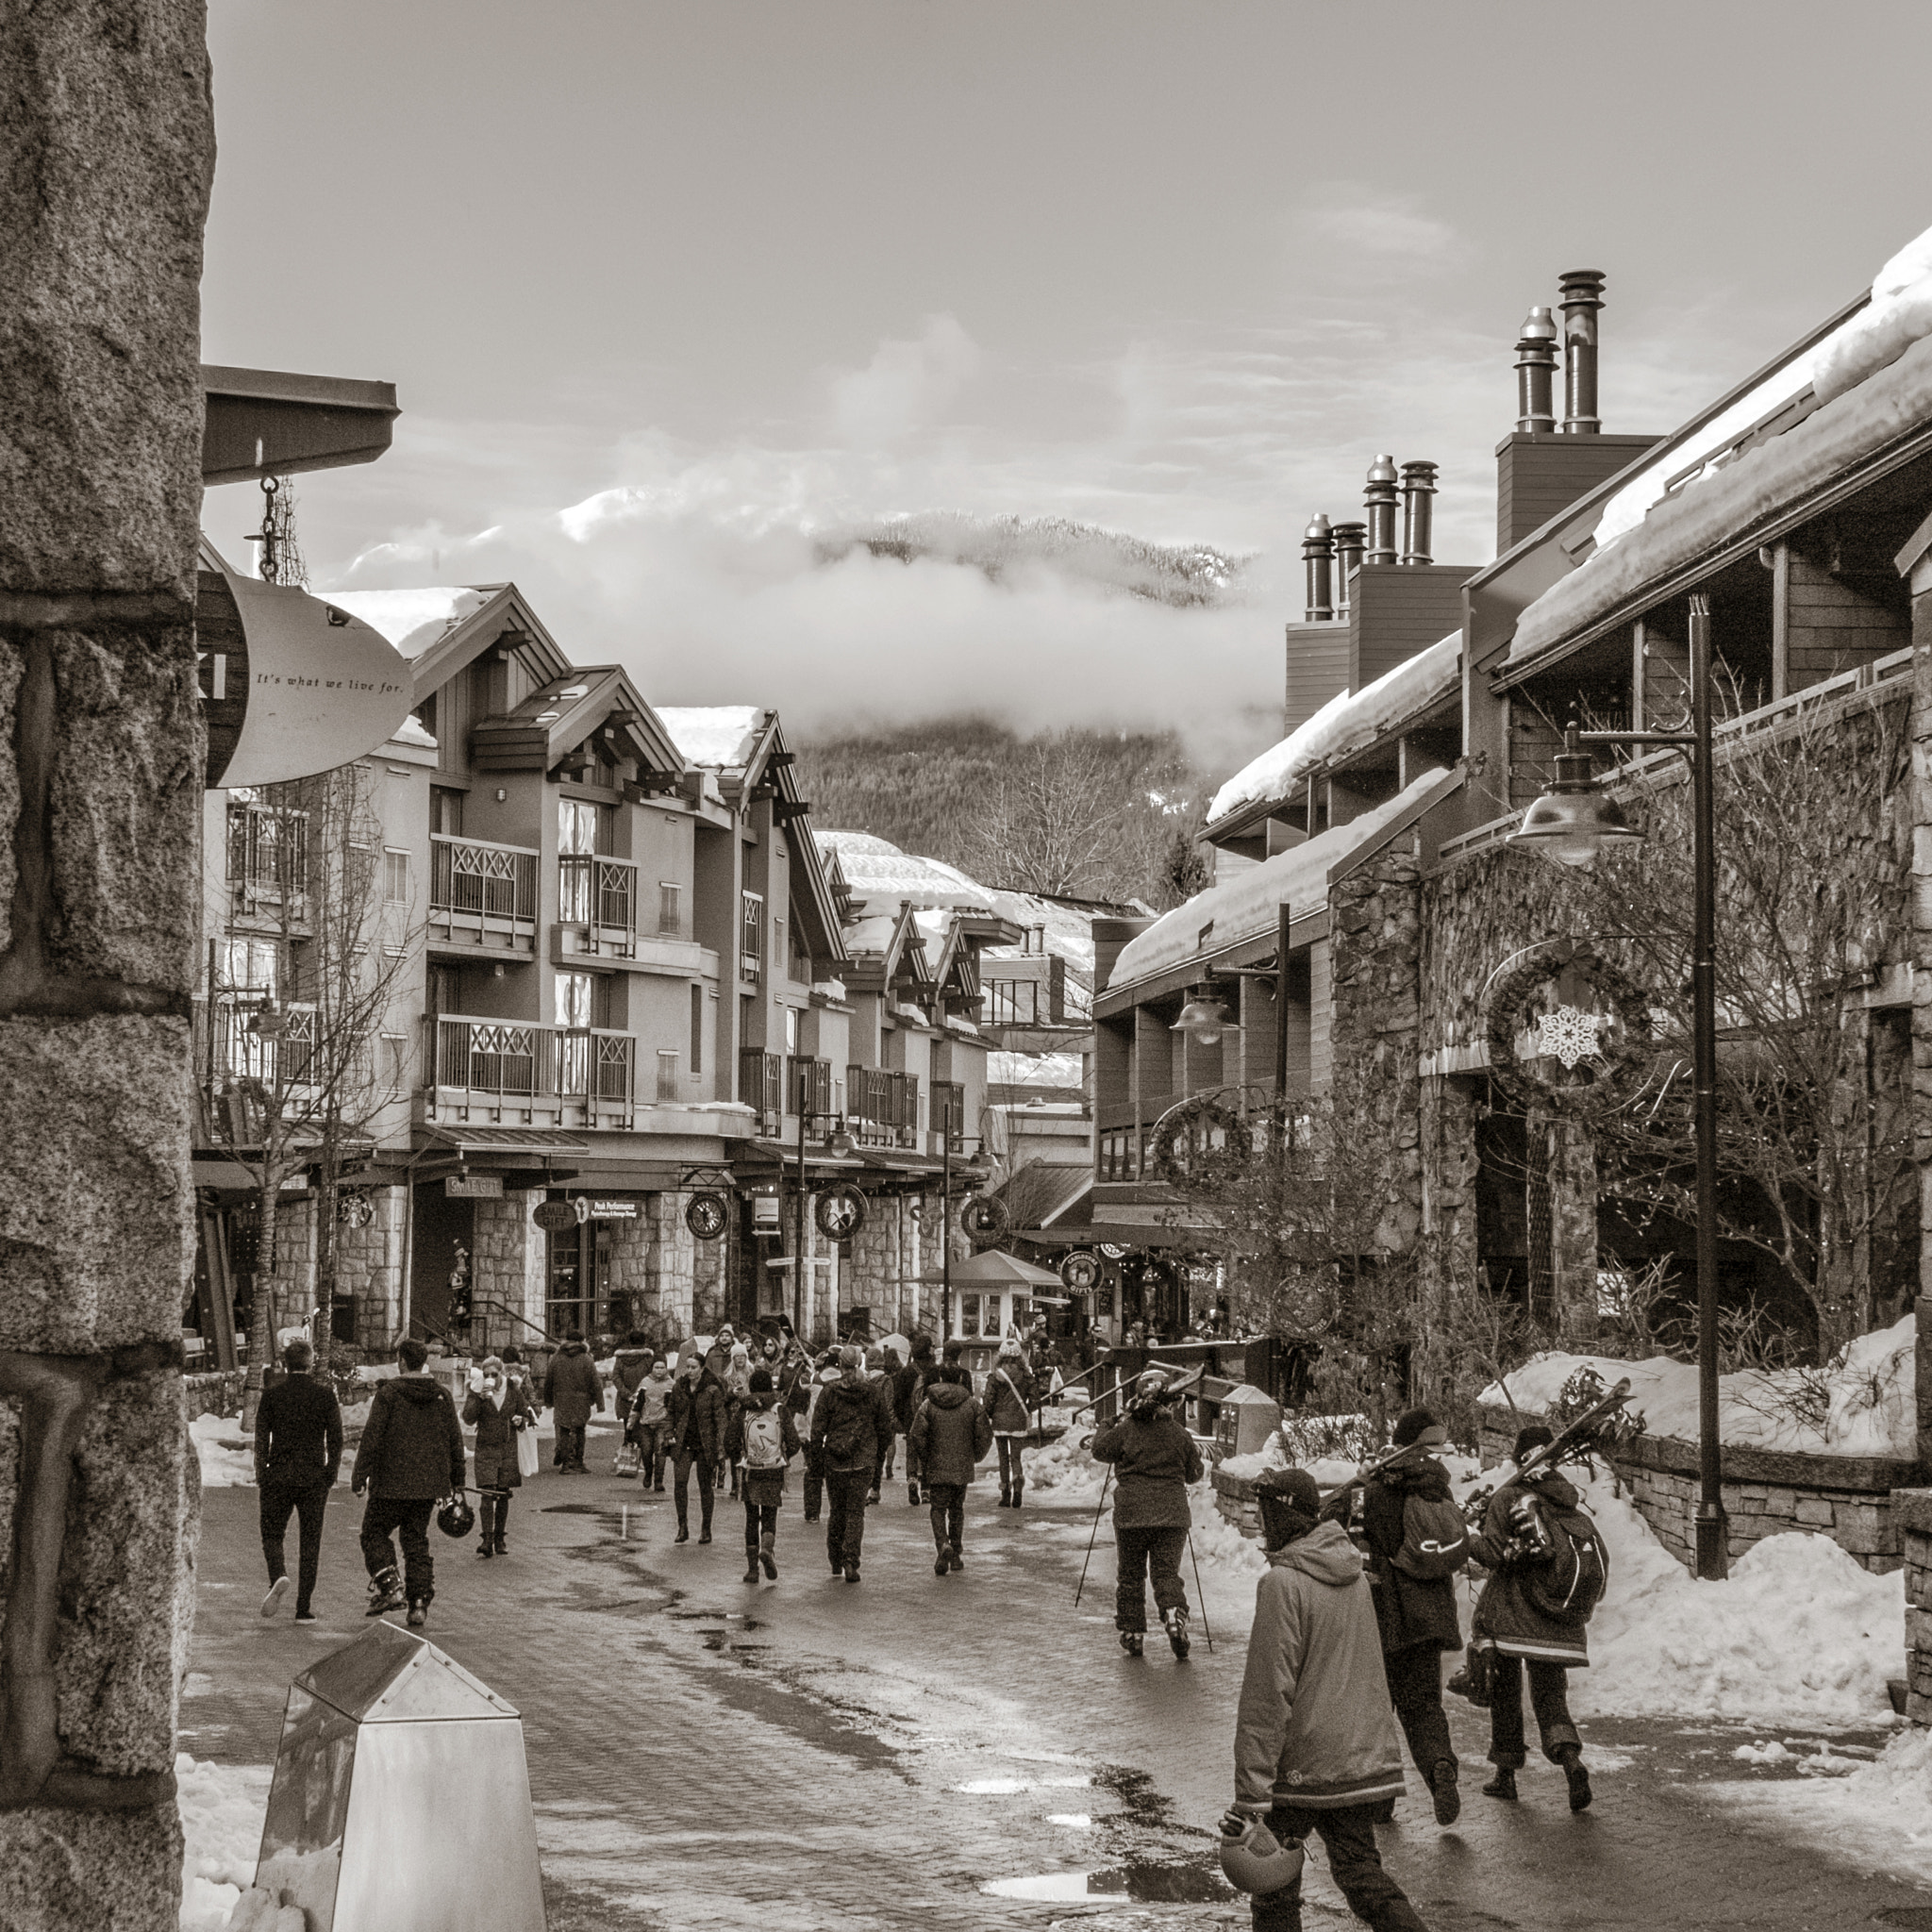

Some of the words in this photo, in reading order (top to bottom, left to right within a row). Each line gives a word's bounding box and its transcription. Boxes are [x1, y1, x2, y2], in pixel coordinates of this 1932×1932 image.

[257, 674, 280, 685] It's
[288, 675, 319, 687] what
[325, 680, 342, 690] we
[349, 679, 374, 691] live
[378, 683, 404, 695] for.
[541, 1206, 568, 1216] SMILE
[542, 1216, 566, 1226] GIFT
[1070, 1285, 1092, 1294] GIFTS
